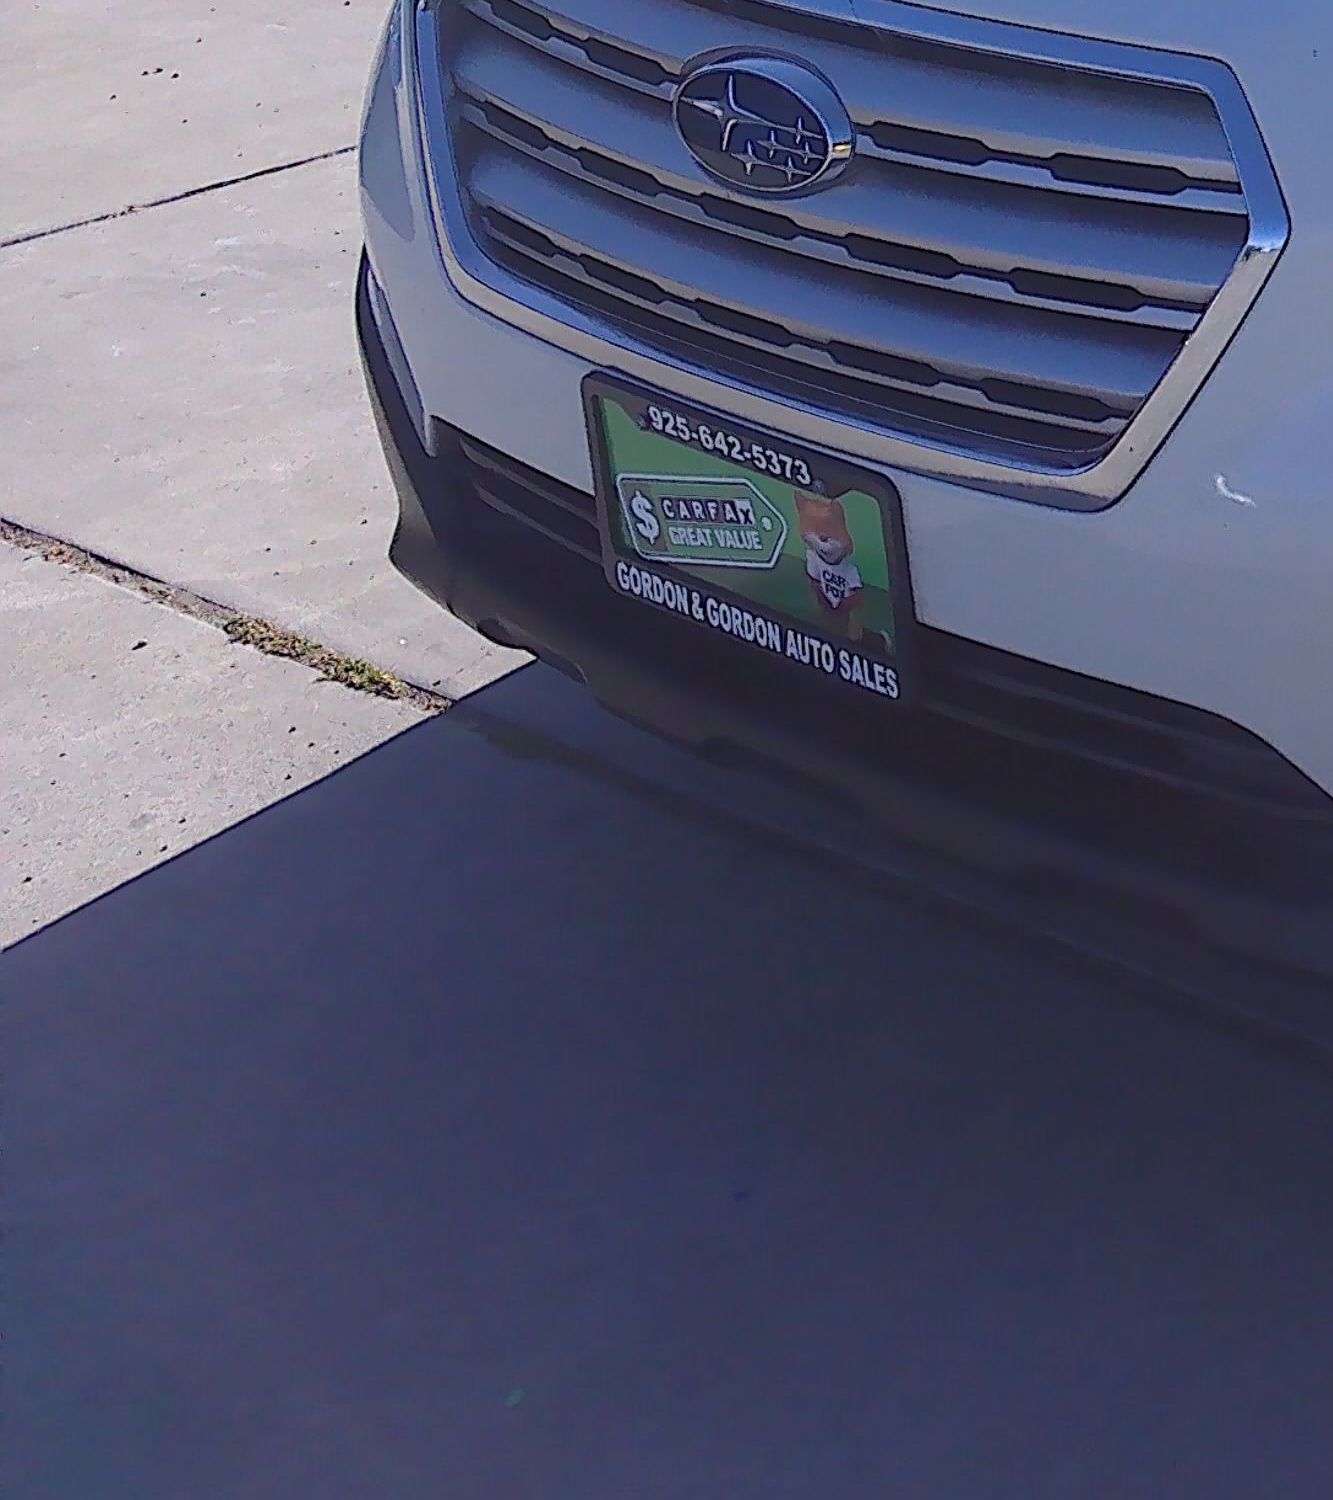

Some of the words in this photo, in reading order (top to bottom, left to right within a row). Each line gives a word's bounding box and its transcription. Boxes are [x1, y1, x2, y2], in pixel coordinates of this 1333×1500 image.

[647, 405, 813, 486] 925-642-5373
[661, 499, 755, 525] CARFAX
[668, 526, 715, 547] GREAT
[714, 527, 763, 550] VALUE
[616, 561, 690, 617] GORDON
[690, 592, 705, 622] &
[706, 597, 782, 653] GORDON
[785, 630, 837, 674] AUTO
[838, 650, 899, 700] SALES
